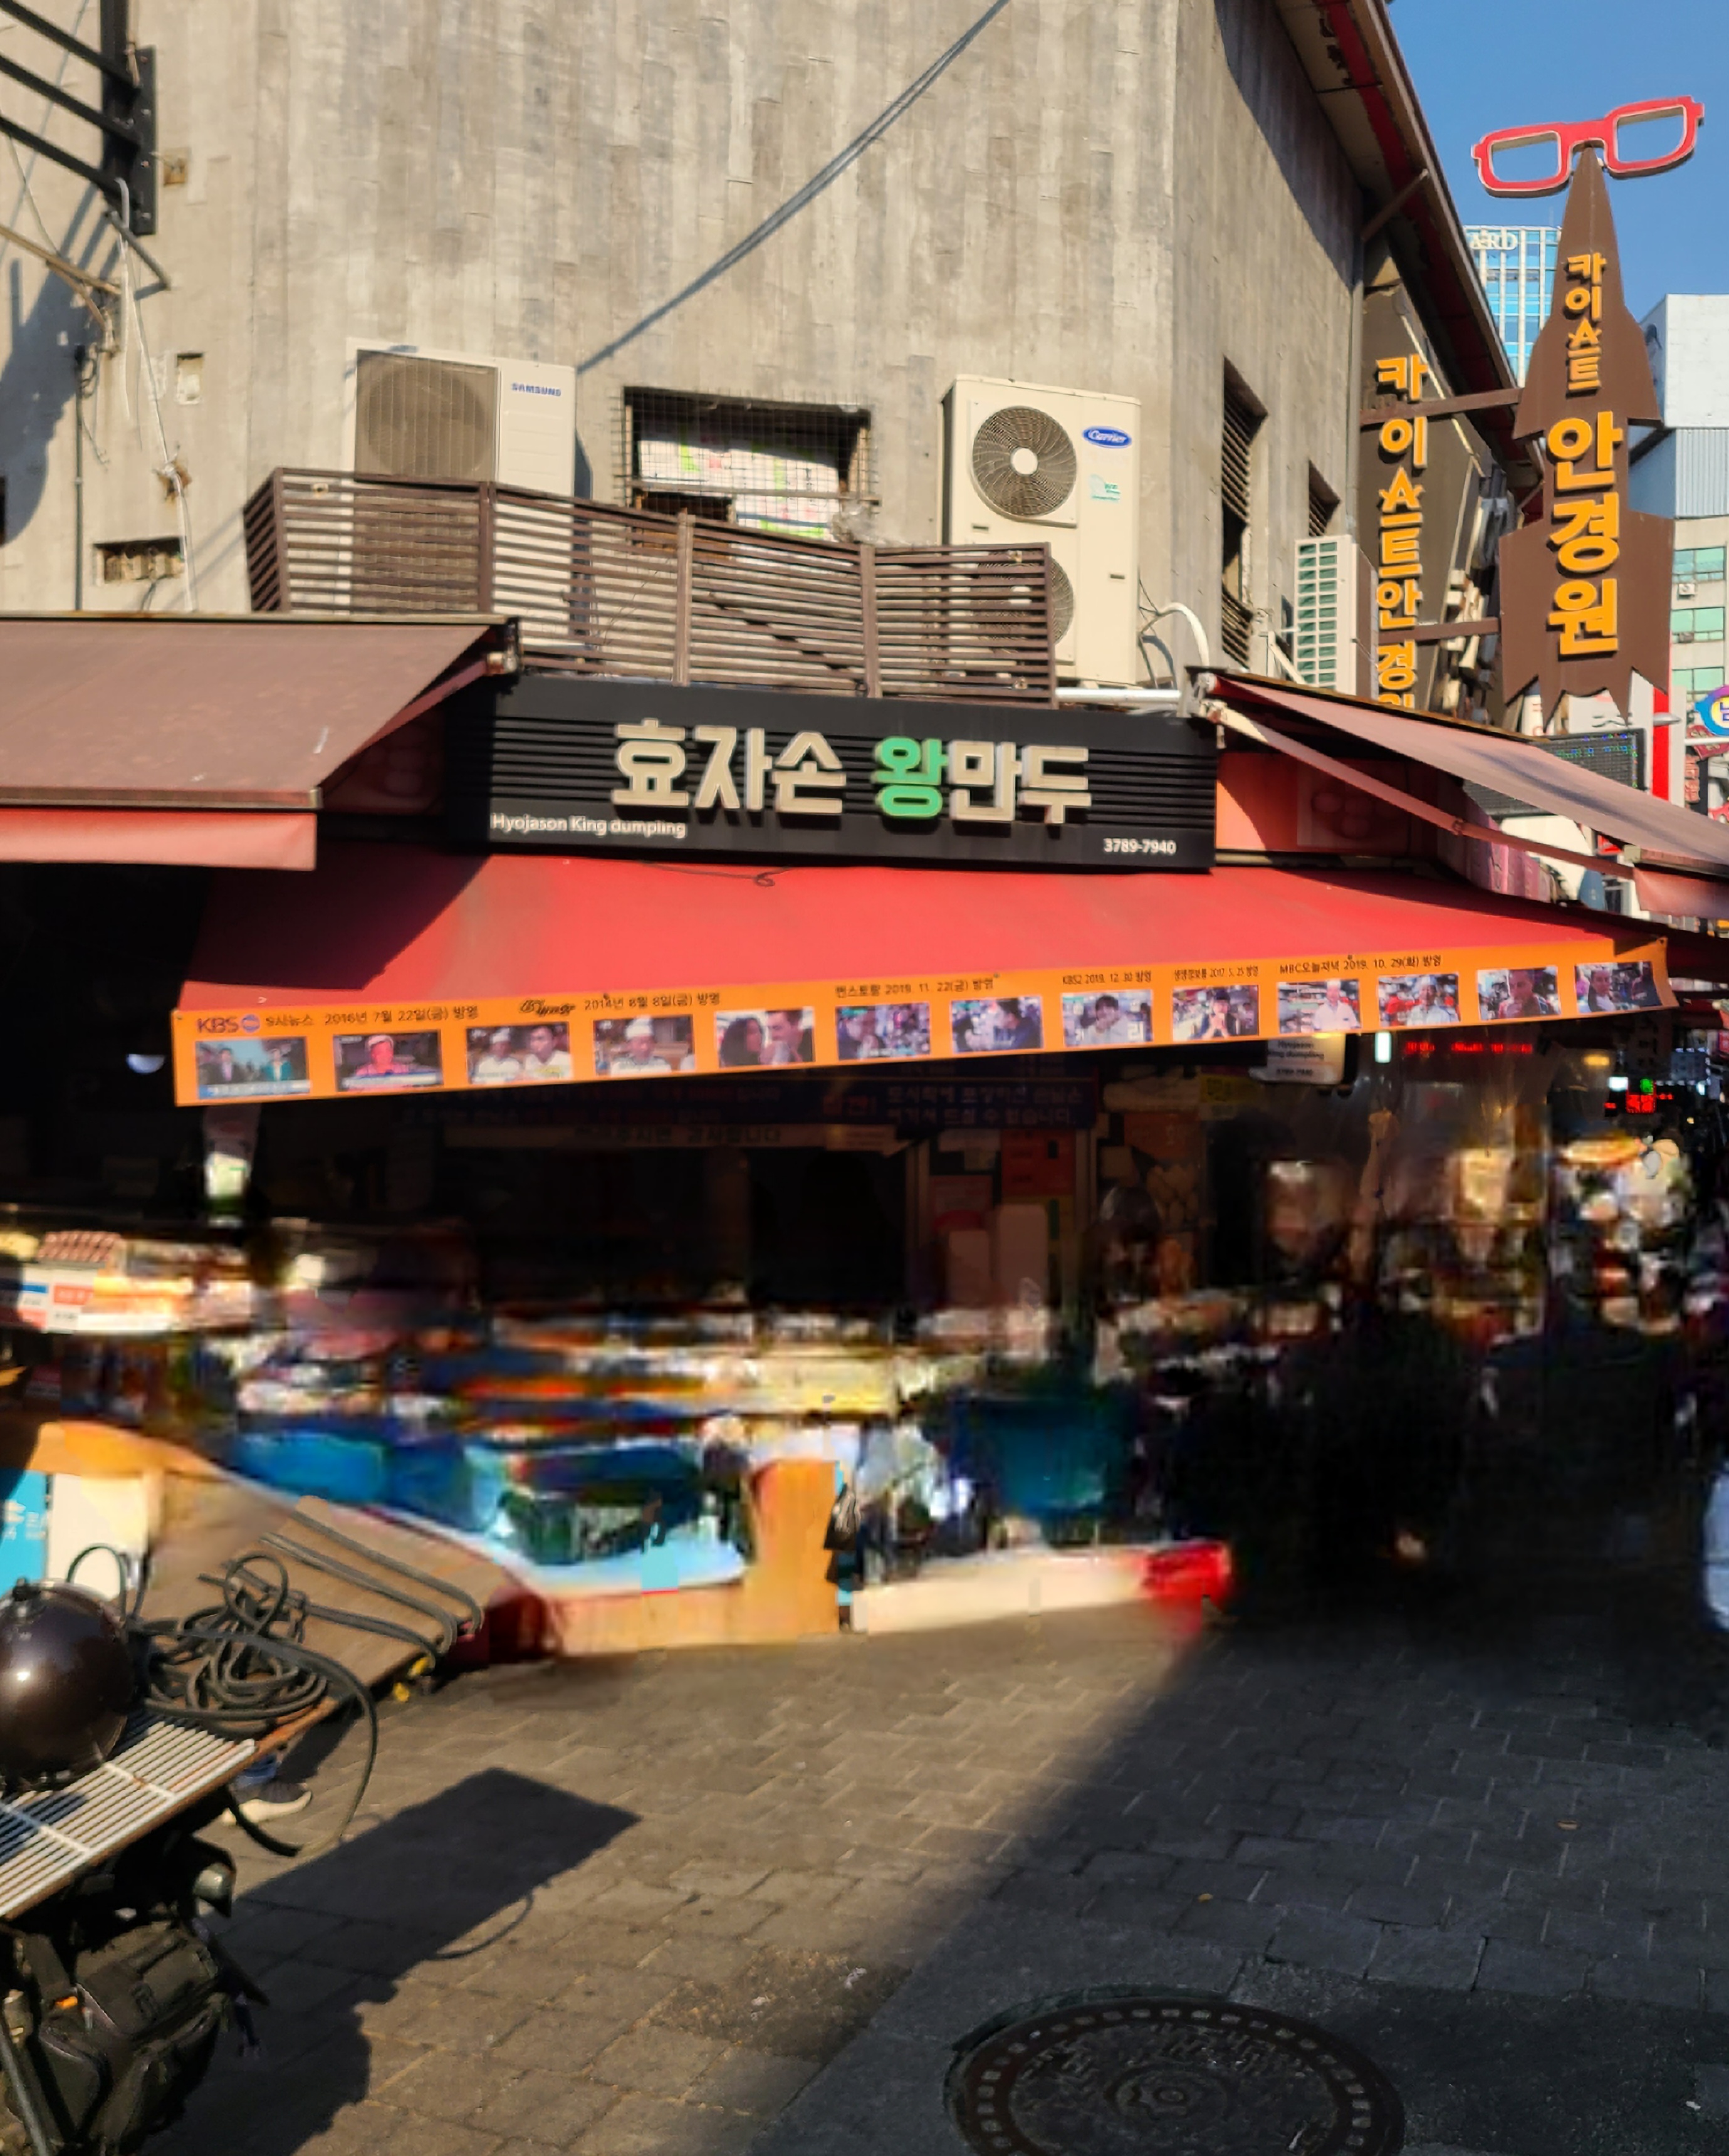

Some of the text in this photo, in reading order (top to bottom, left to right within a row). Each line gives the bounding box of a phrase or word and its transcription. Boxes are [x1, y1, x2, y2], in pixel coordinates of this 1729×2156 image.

[1567, 253, 1607, 392] 카이스트
[511, 382, 562, 397] SAMSUNG
[1547, 411, 1623, 657] 안경원
[612, 718, 1092, 824] 효자손 왕만두
[491, 813, 686, 839] Hyojason King dumpling
[1103, 838, 1177, 854] 3789-7940
[196, 1017, 239, 1034] KBS
